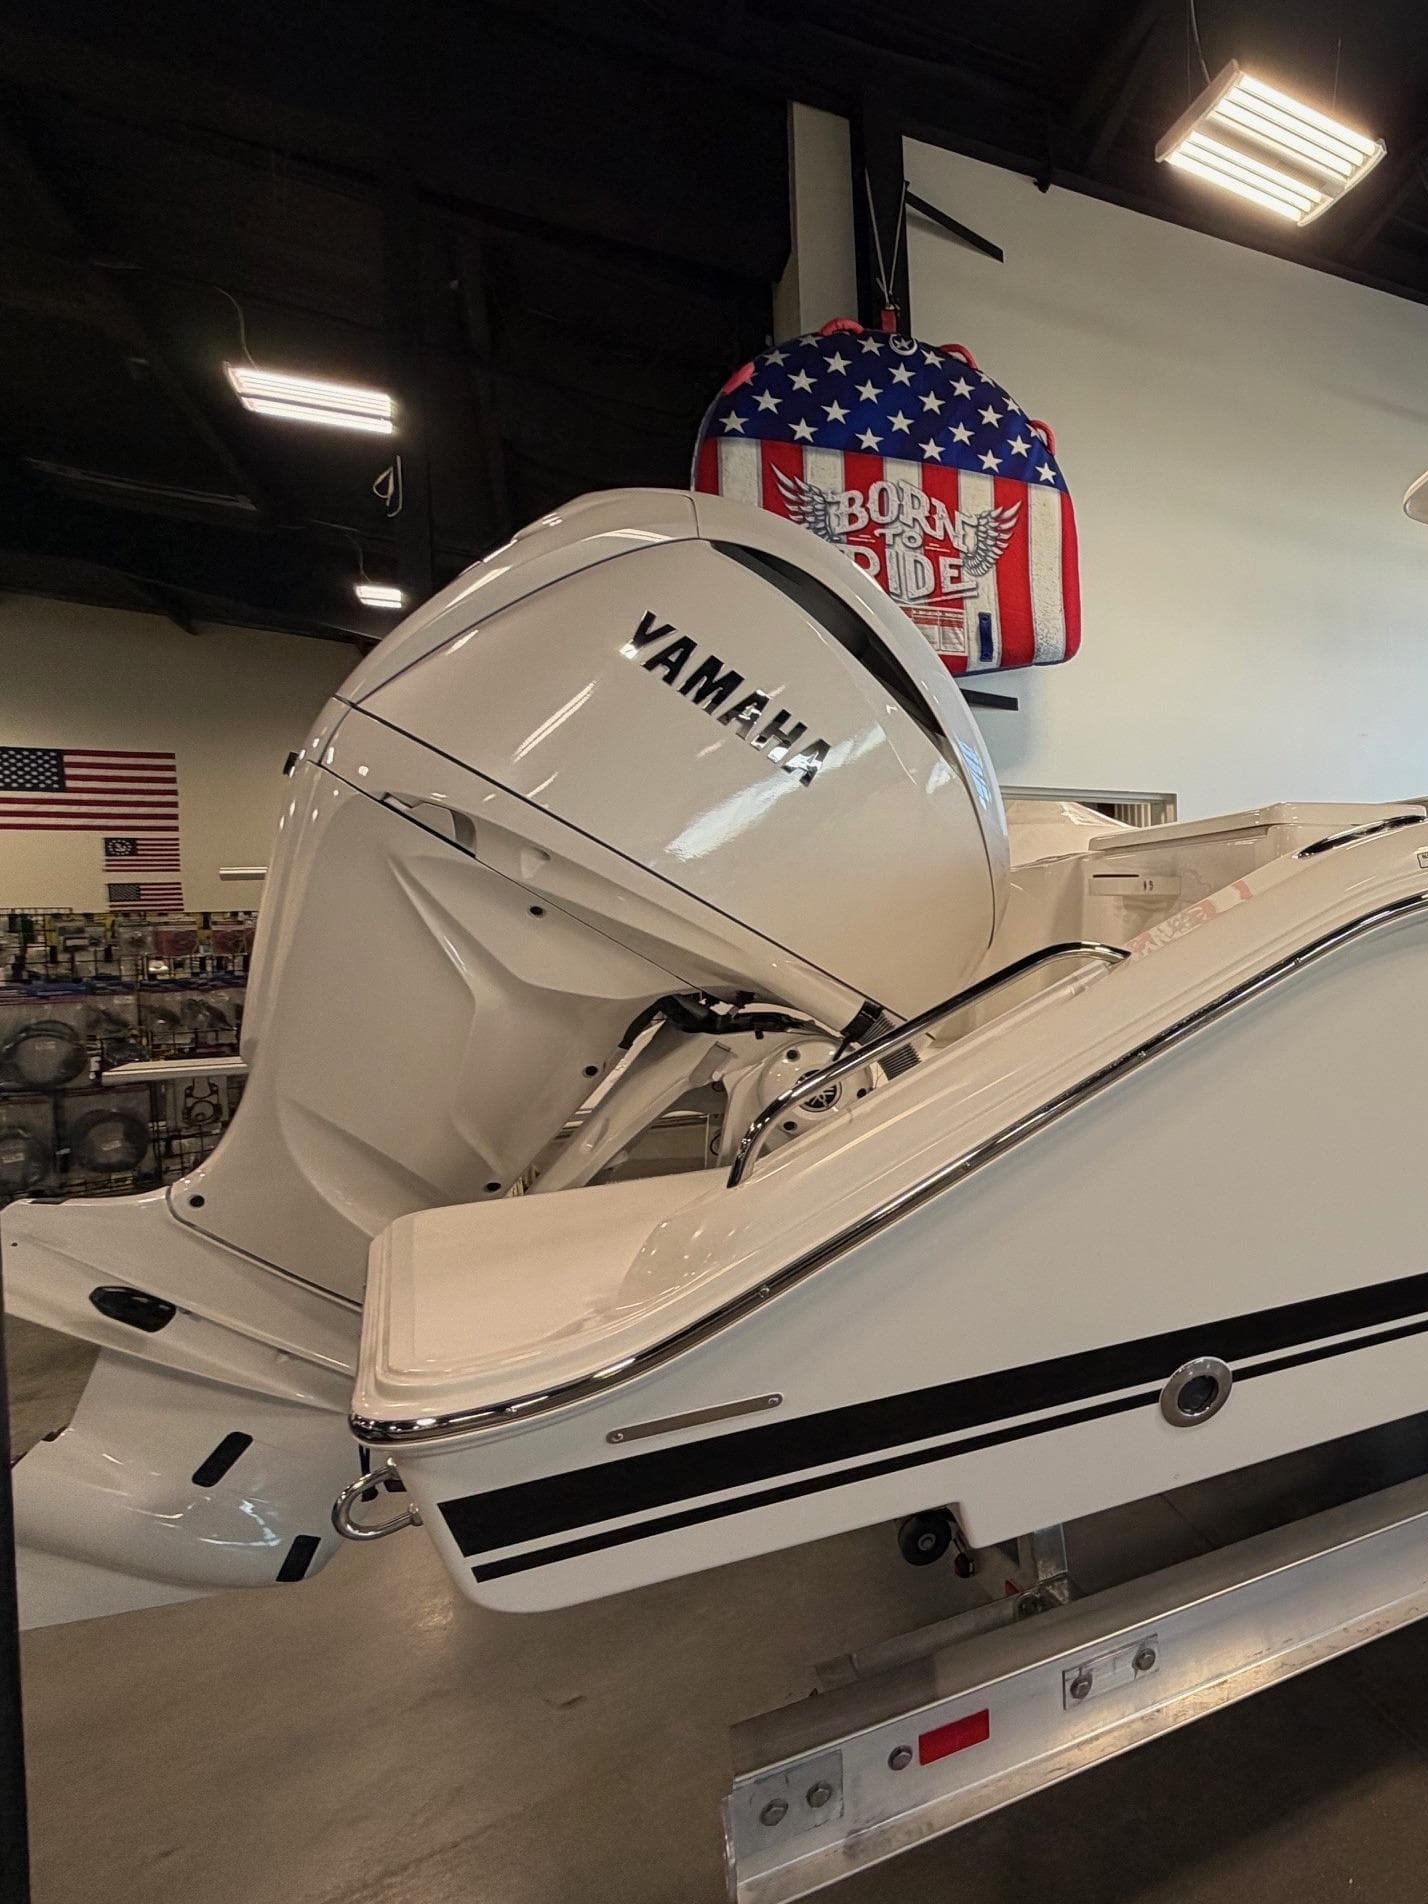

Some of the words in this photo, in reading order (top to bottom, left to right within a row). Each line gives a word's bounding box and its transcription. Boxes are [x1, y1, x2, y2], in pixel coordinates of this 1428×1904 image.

[829, 480, 978, 553] BORN
[874, 526, 923, 549] TO
[620, 609, 832, 788] YAMAHA
